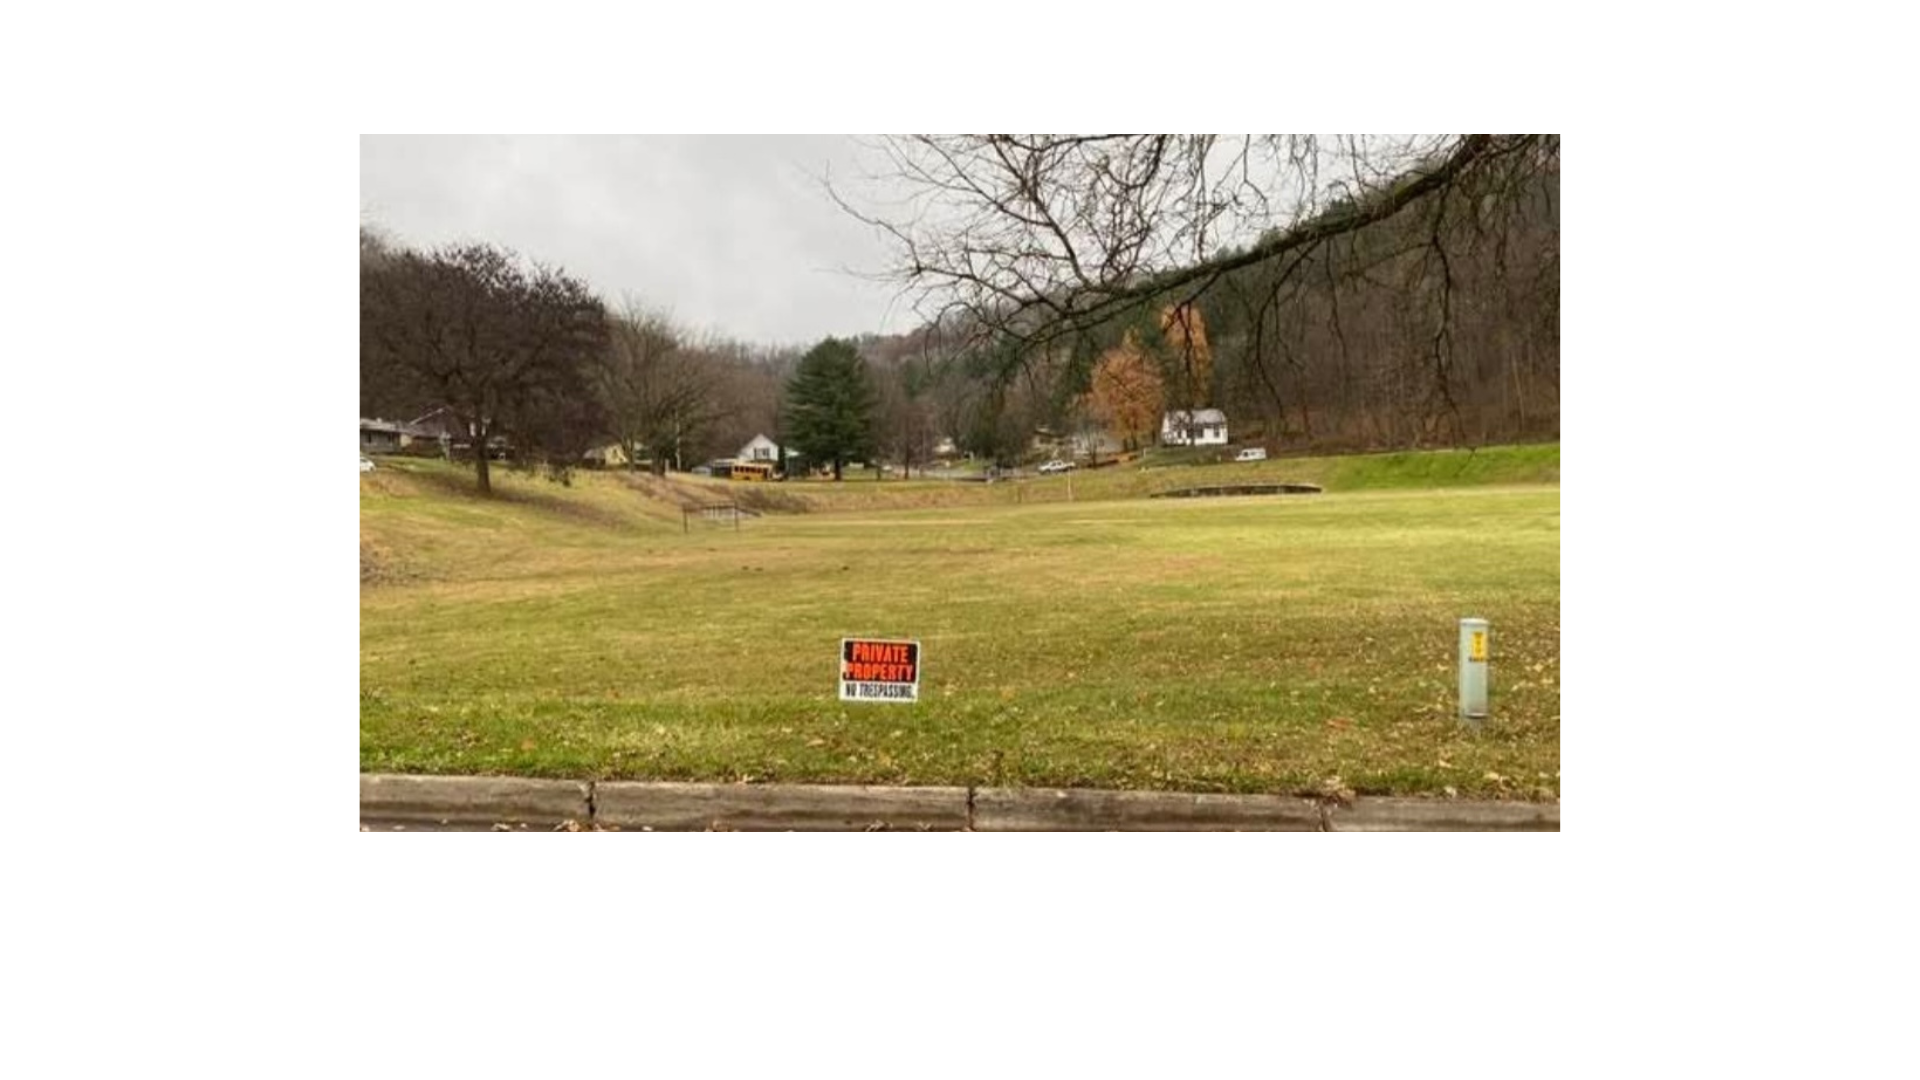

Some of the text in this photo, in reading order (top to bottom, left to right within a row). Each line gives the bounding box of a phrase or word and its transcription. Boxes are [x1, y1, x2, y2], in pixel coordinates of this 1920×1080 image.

[852, 643, 909, 663] PRIVATE
[845, 662, 913, 681] PROPERTY
[845, 683, 857, 697] NO
